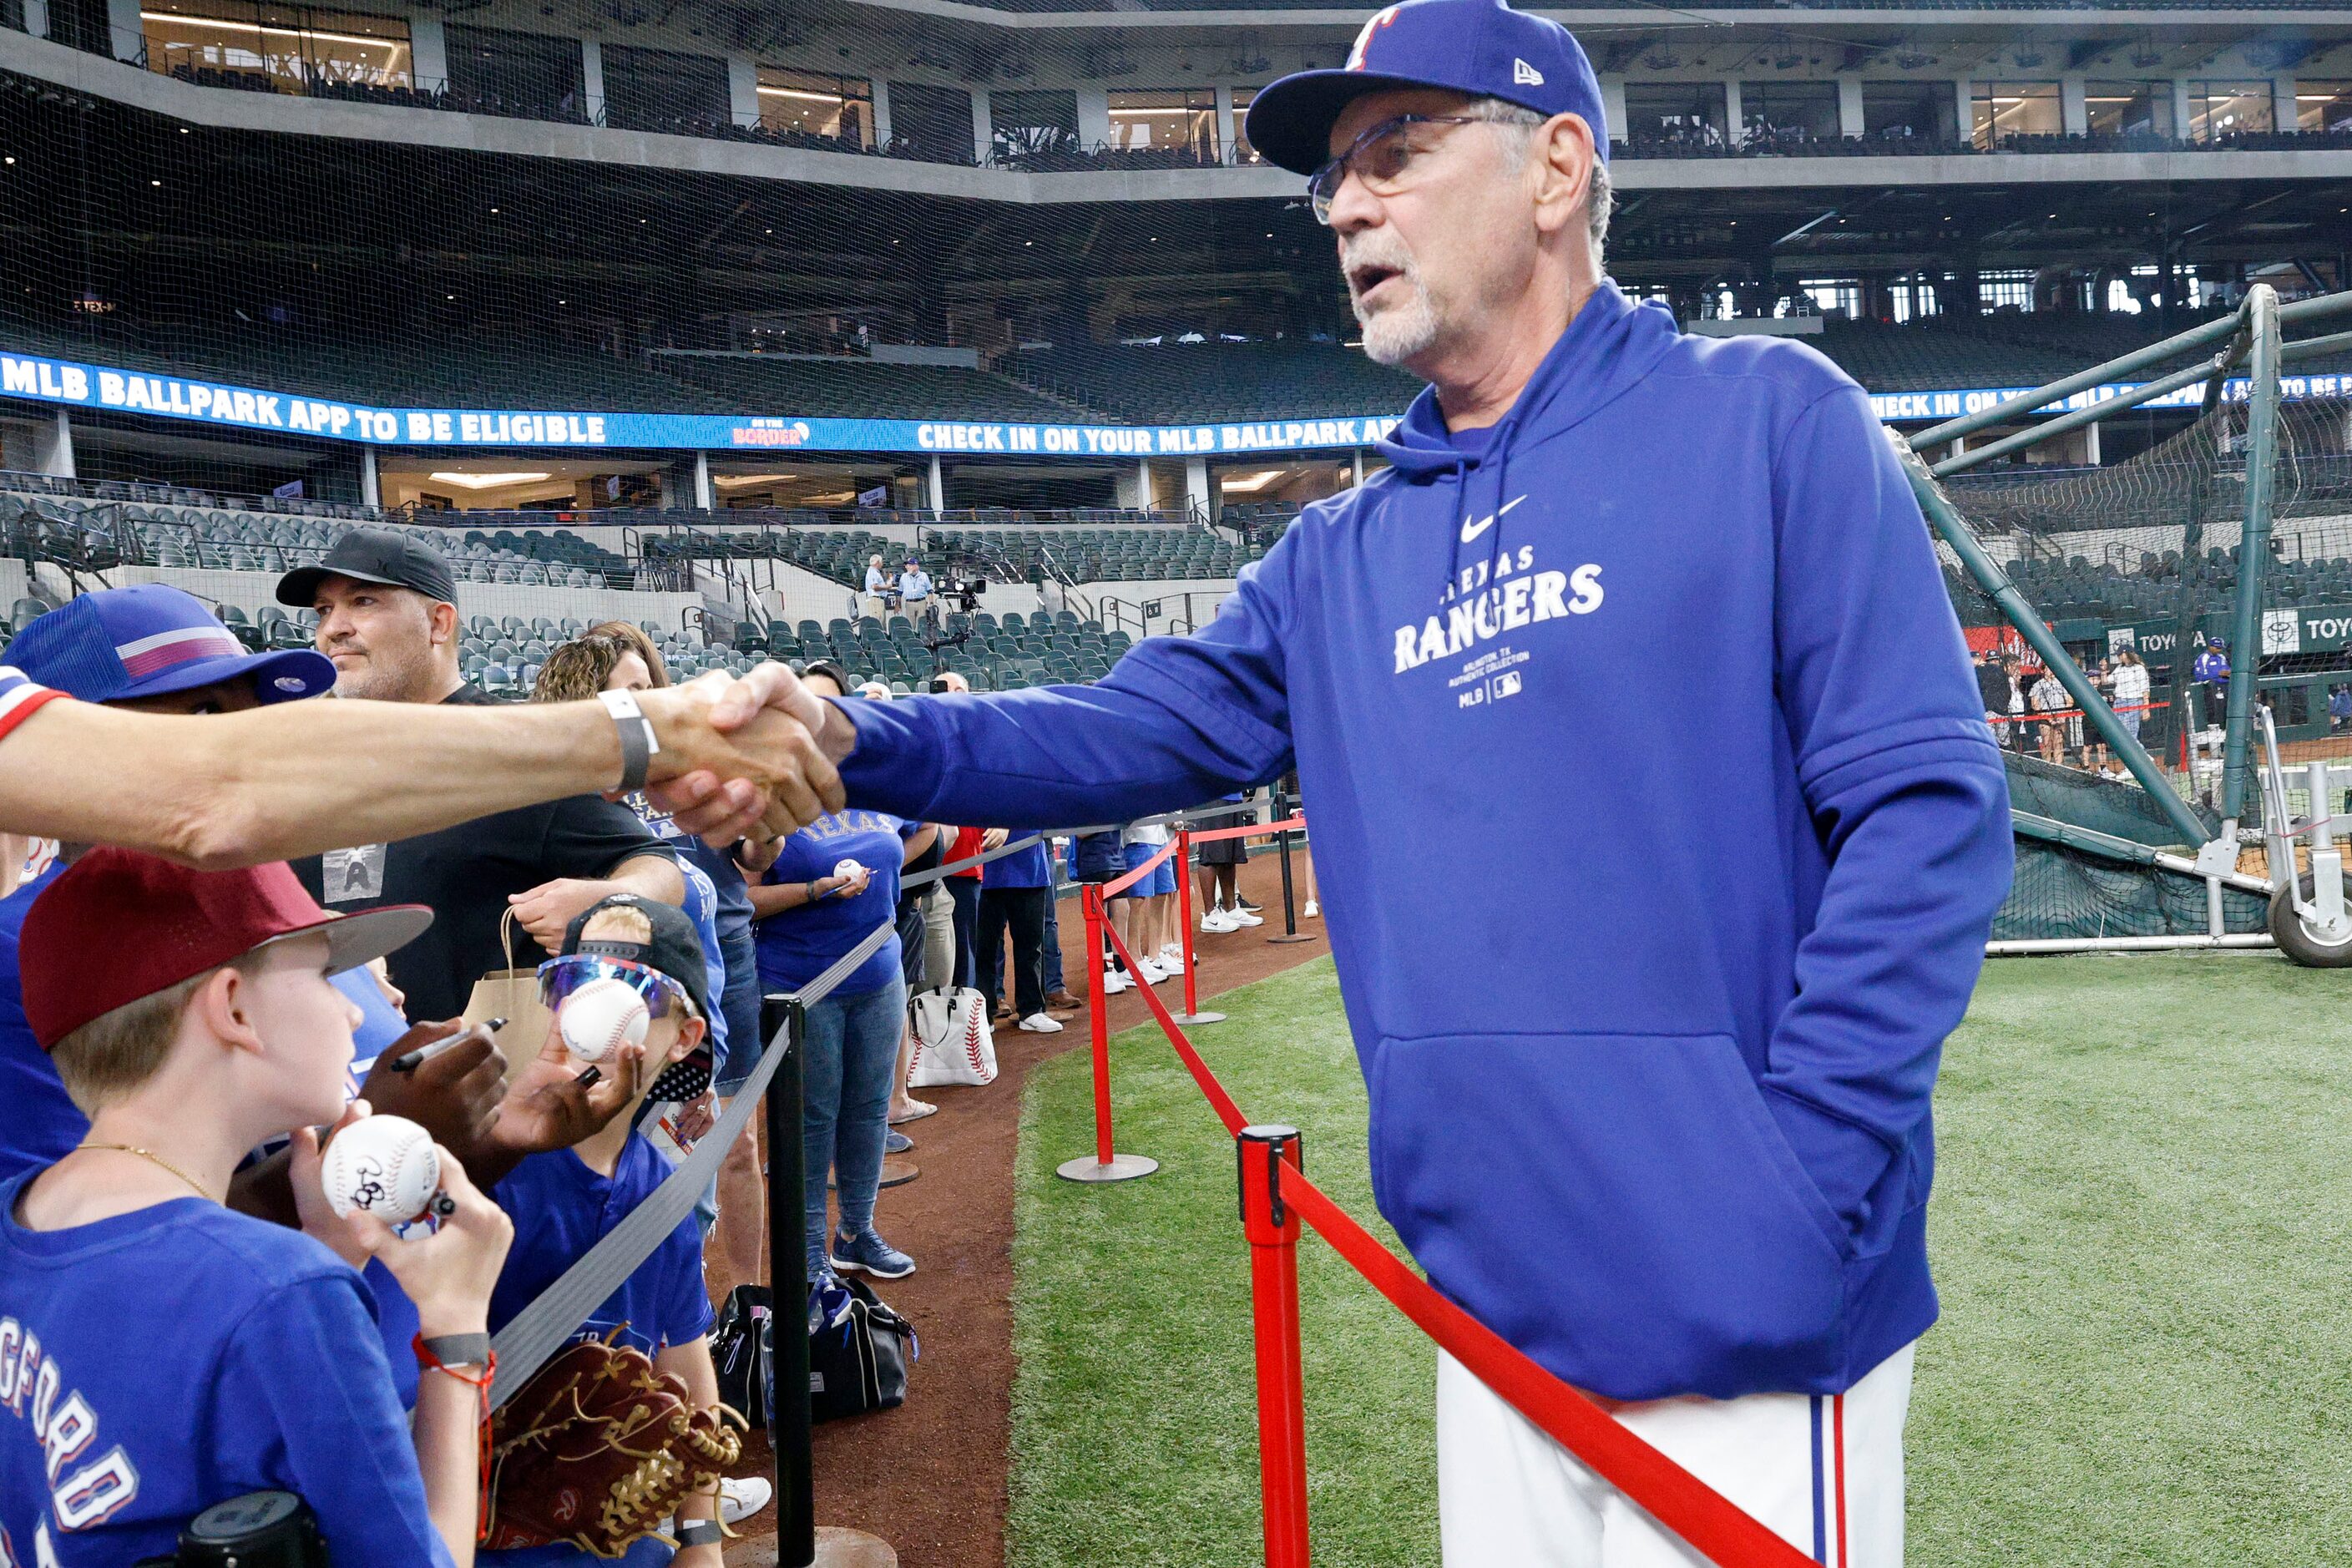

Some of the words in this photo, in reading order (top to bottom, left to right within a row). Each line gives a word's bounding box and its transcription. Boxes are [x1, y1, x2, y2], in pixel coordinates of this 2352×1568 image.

[1, 357, 89, 401] MLB
[99, 372, 283, 427] BALLPARK
[289, 399, 350, 435] APP
[355, 409, 397, 441] TO
[407, 413, 453, 442] BE
[460, 414, 605, 443] ELIGIBLE
[1870, 395, 1934, 417] HECK
[1935, 393, 1960, 416] IN
[1965, 392, 1997, 413] ON
[733, 428, 802, 446] BORDER
[918, 424, 1004, 450] CHECK
[1009, 427, 1037, 451] IN
[1044, 427, 1079, 452] ON
[1084, 428, 1152, 453] YOUR
[1158, 428, 1214, 453] MLB
[1222, 421, 1358, 449] BALLPARK
[1362, 418, 1404, 443] AP
[1393, 564, 1604, 675] RANGERS
[2306, 618, 2352, 640] TOY
[2139, 630, 2207, 653] TOYA
[1485, 650, 1530, 674] COLLECTION
[1459, 687, 1484, 709] MLB
